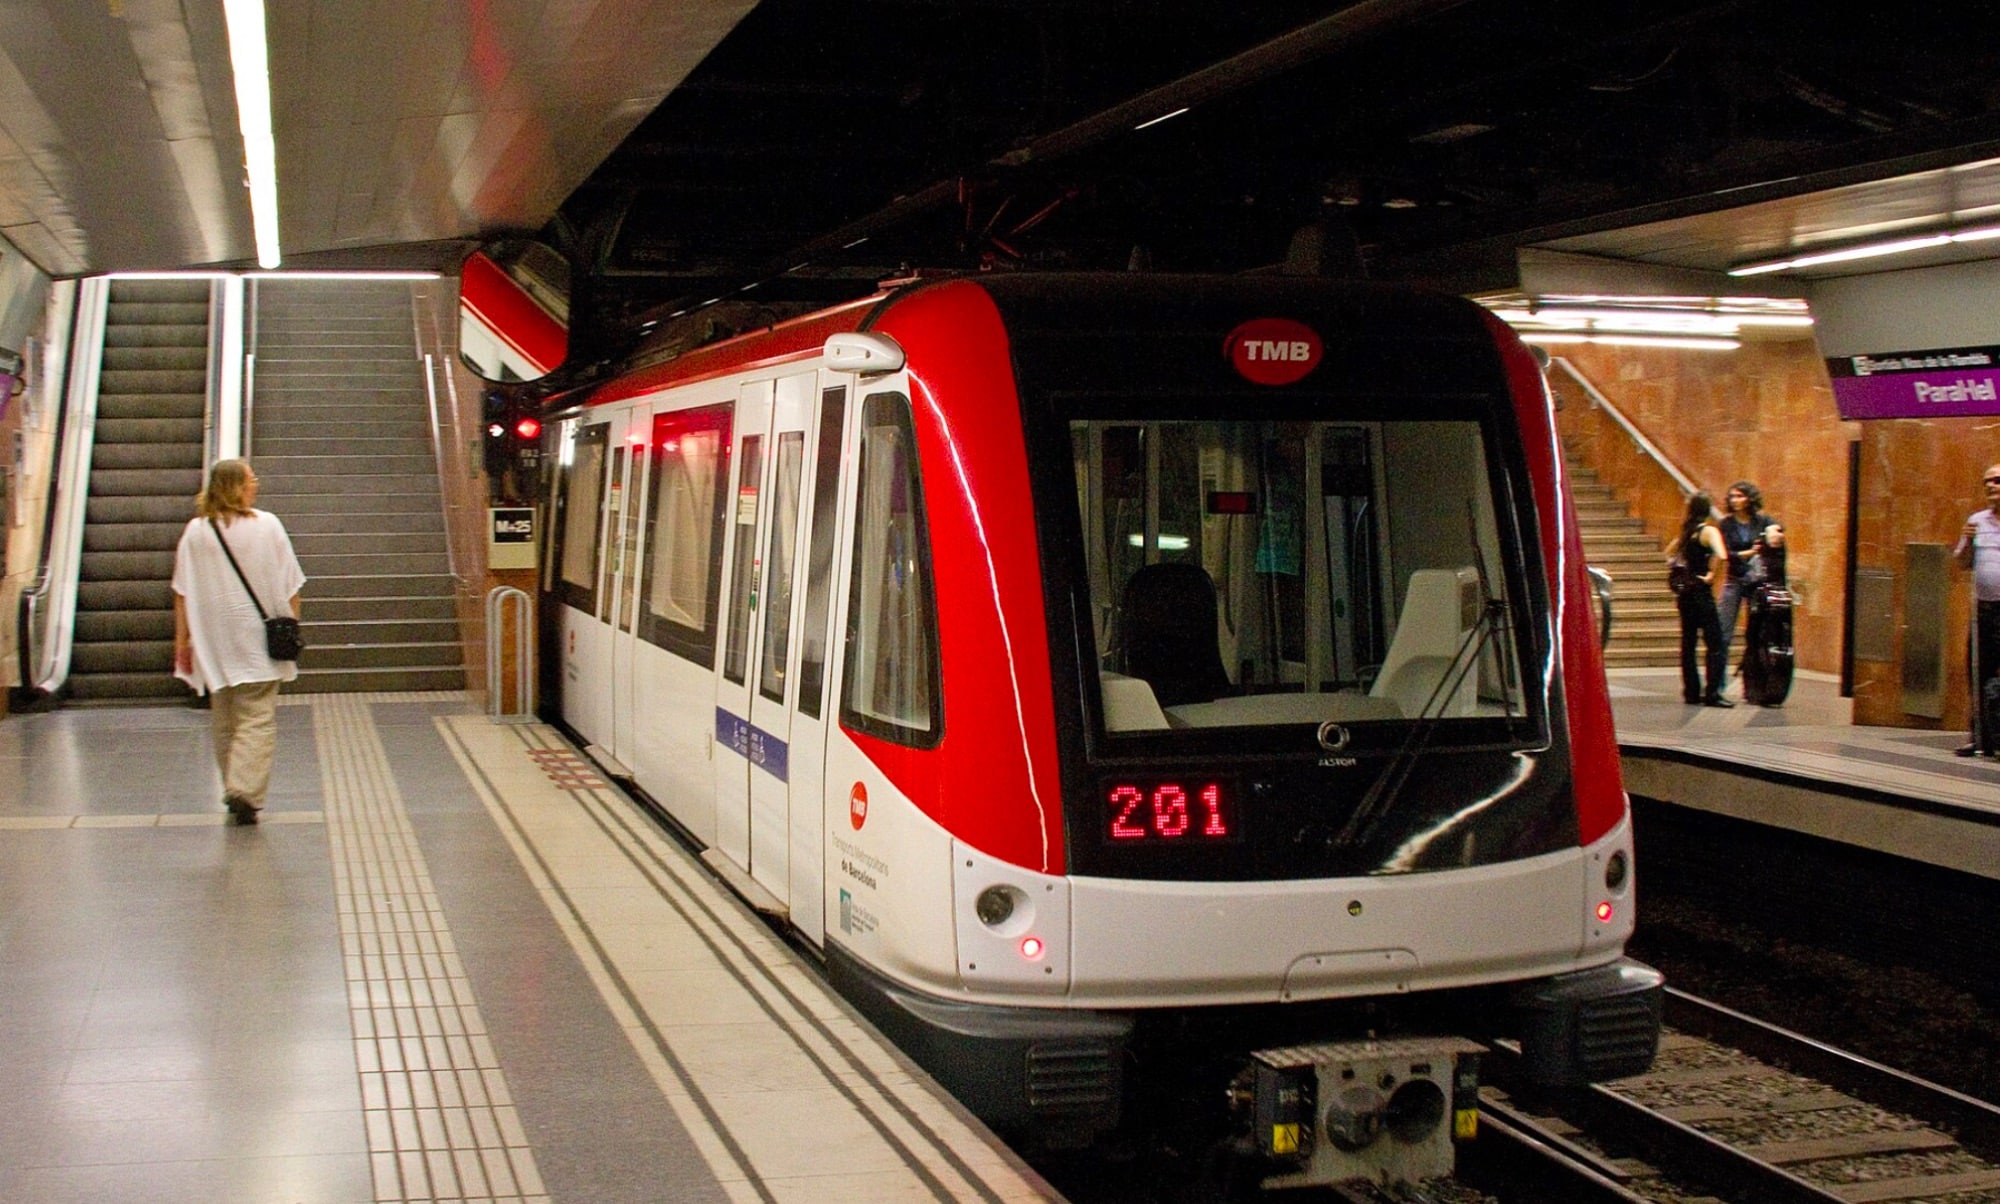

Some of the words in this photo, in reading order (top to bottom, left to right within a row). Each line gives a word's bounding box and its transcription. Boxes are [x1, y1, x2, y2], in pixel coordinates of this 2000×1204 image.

[1243, 340, 1310, 361] TMB
[852, 797, 866, 817] TMB
[1111, 785, 1226, 837] 201
[841, 859, 848, 873] de
[849, 861, 877, 890] Barcelona
